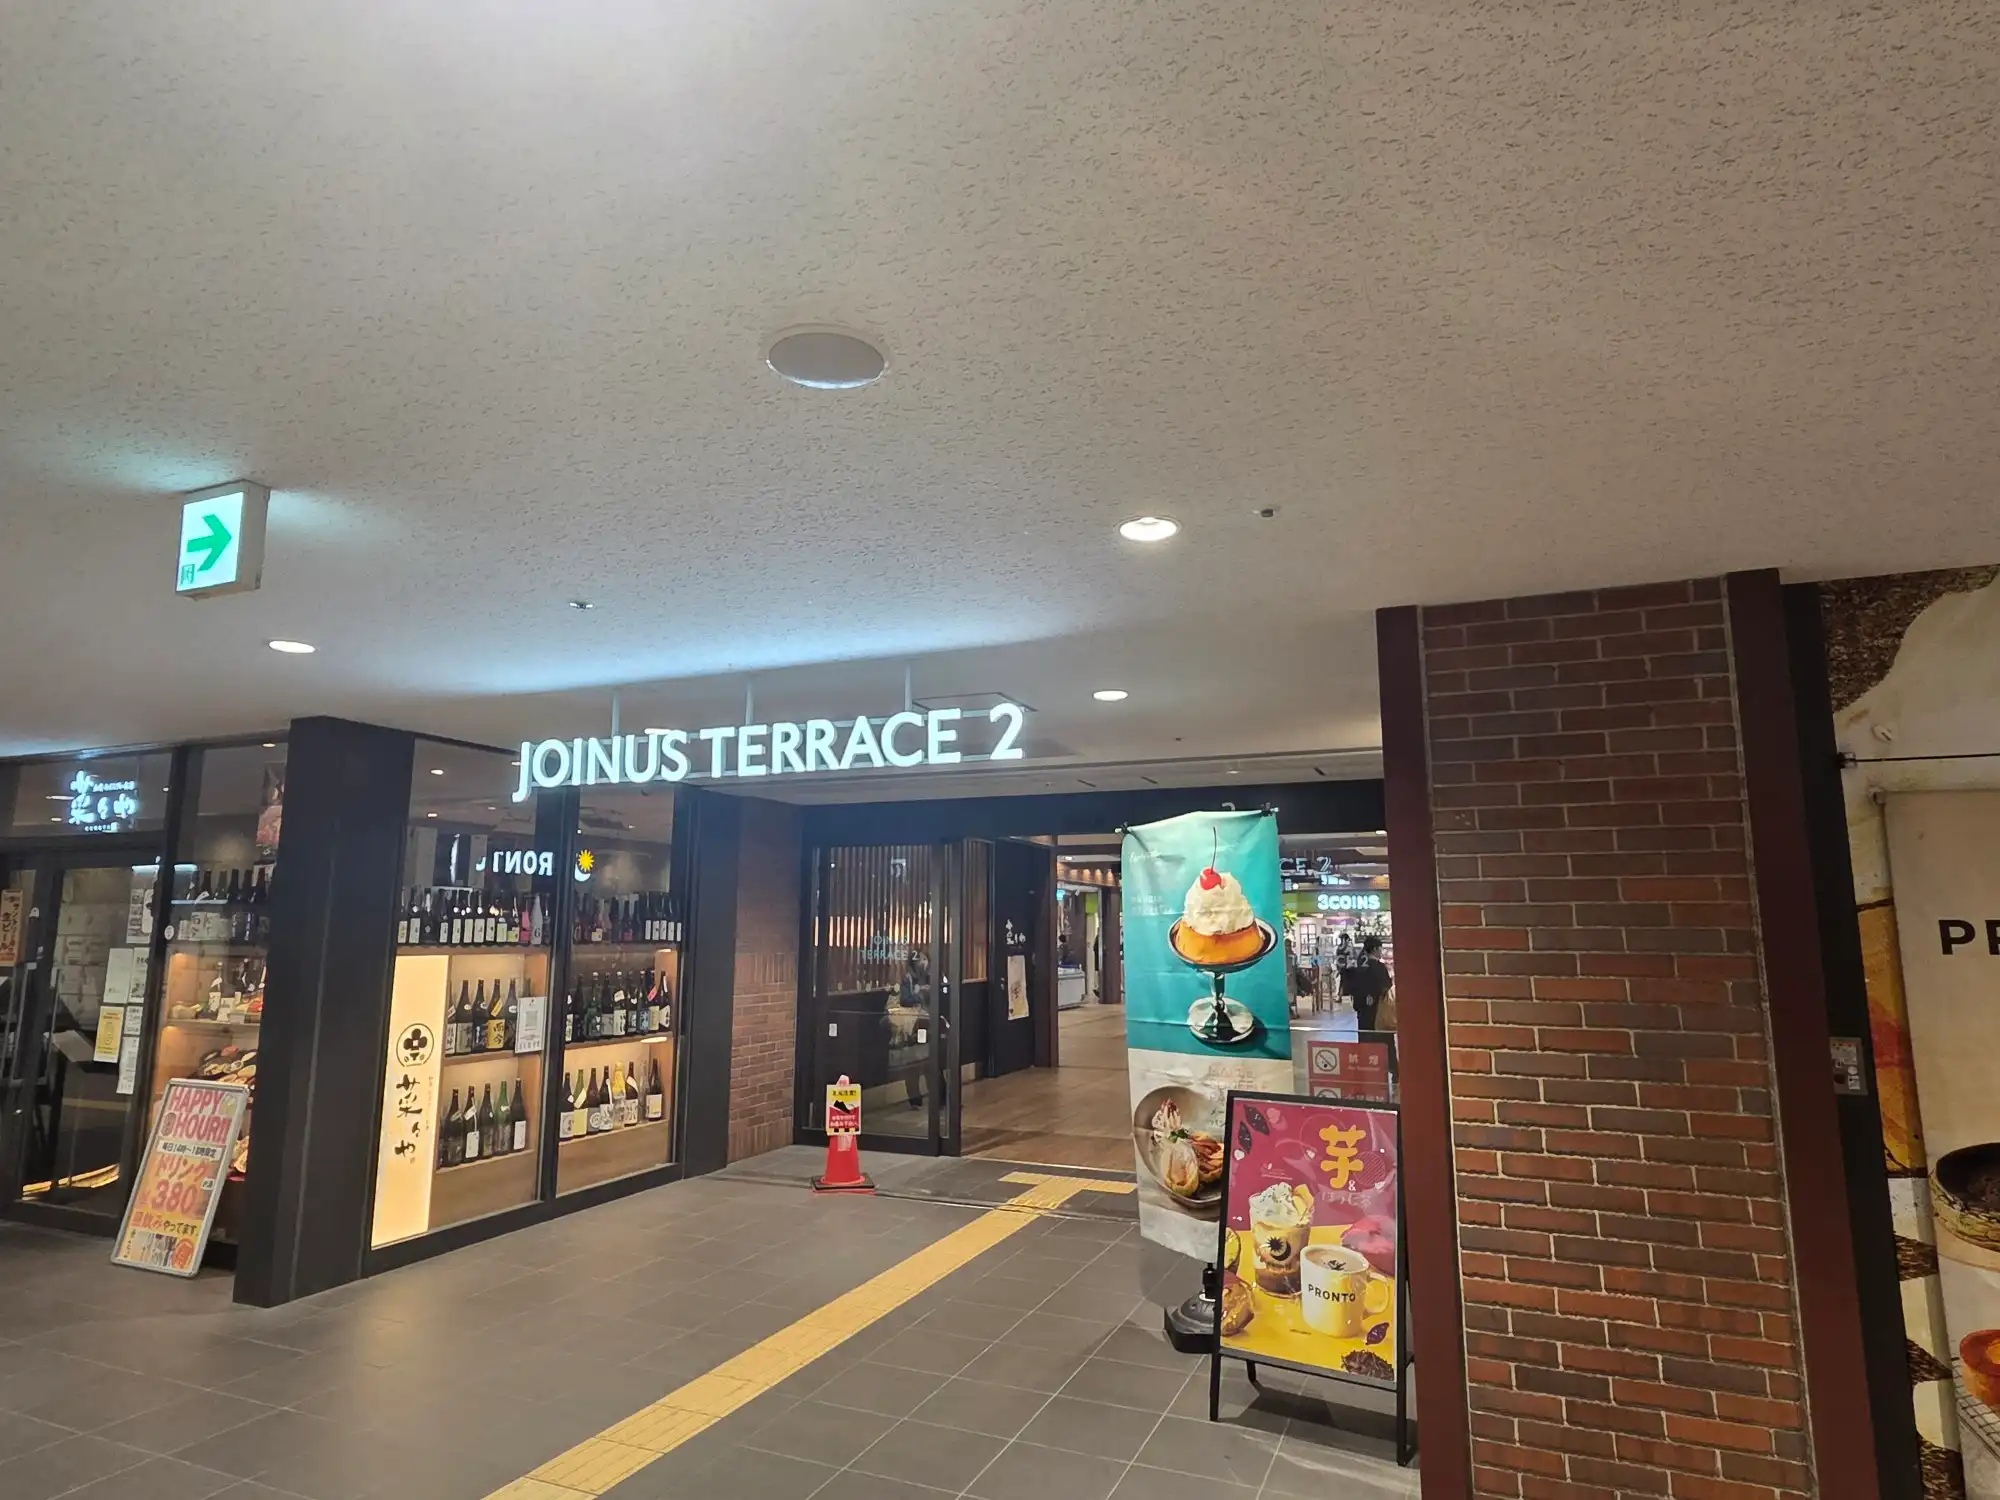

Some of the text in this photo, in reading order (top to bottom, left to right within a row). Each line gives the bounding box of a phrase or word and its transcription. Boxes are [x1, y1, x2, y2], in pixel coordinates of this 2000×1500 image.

[511, 703, 1026, 802] JOINUS TERRACE 2
[1317, 894, 1380, 910] 3COINS
[169, 1087, 224, 1117] HAPPY
[394, 1073, 423, 1157] 菜々や
[1319, 1124, 1366, 1189] 芋
[1348, 1180, 1357, 1192] &
[1307, 1283, 1357, 1303] PRONTO
